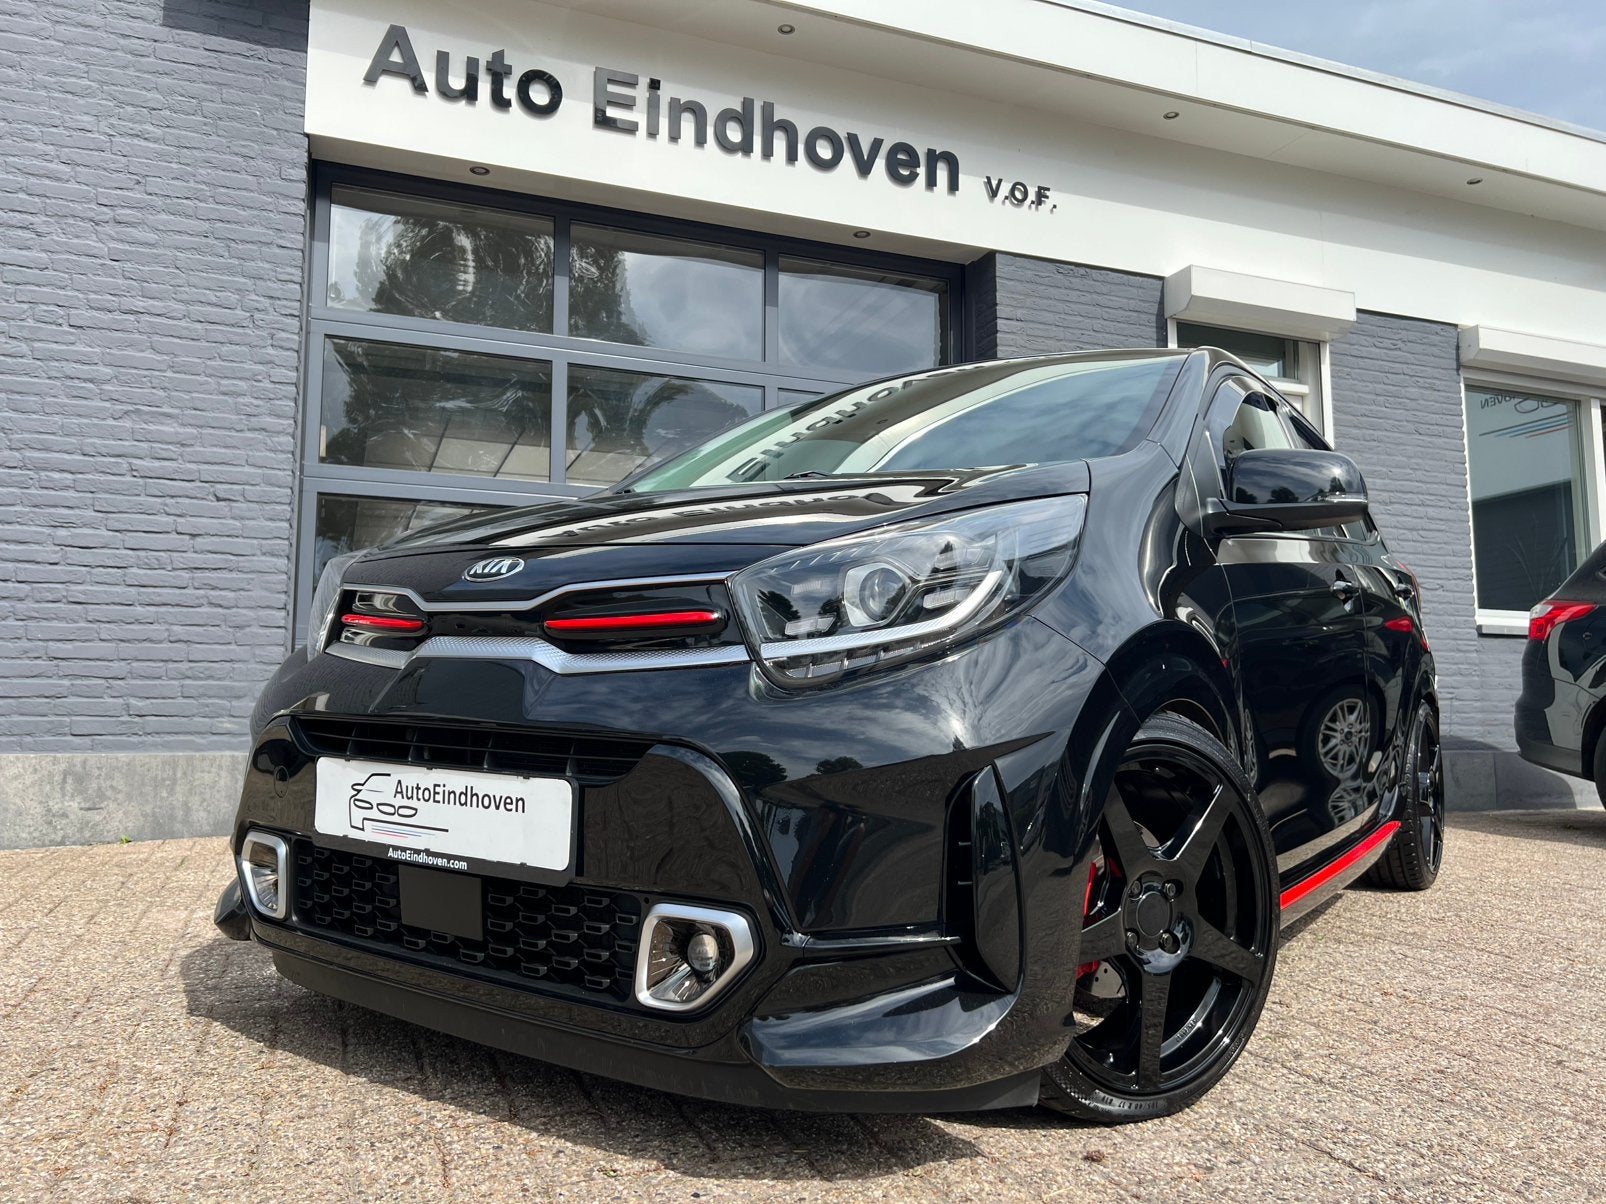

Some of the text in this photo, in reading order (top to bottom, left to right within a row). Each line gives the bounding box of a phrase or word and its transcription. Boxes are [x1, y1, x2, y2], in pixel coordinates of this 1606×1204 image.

[362, 23, 1057, 209] Auto Eindhoven V.O.F.
[469, 558, 513, 575] KIA
[394, 779, 526, 814] AutoEindhoven
[387, 847, 468, 871] AutoEindhoven.com
